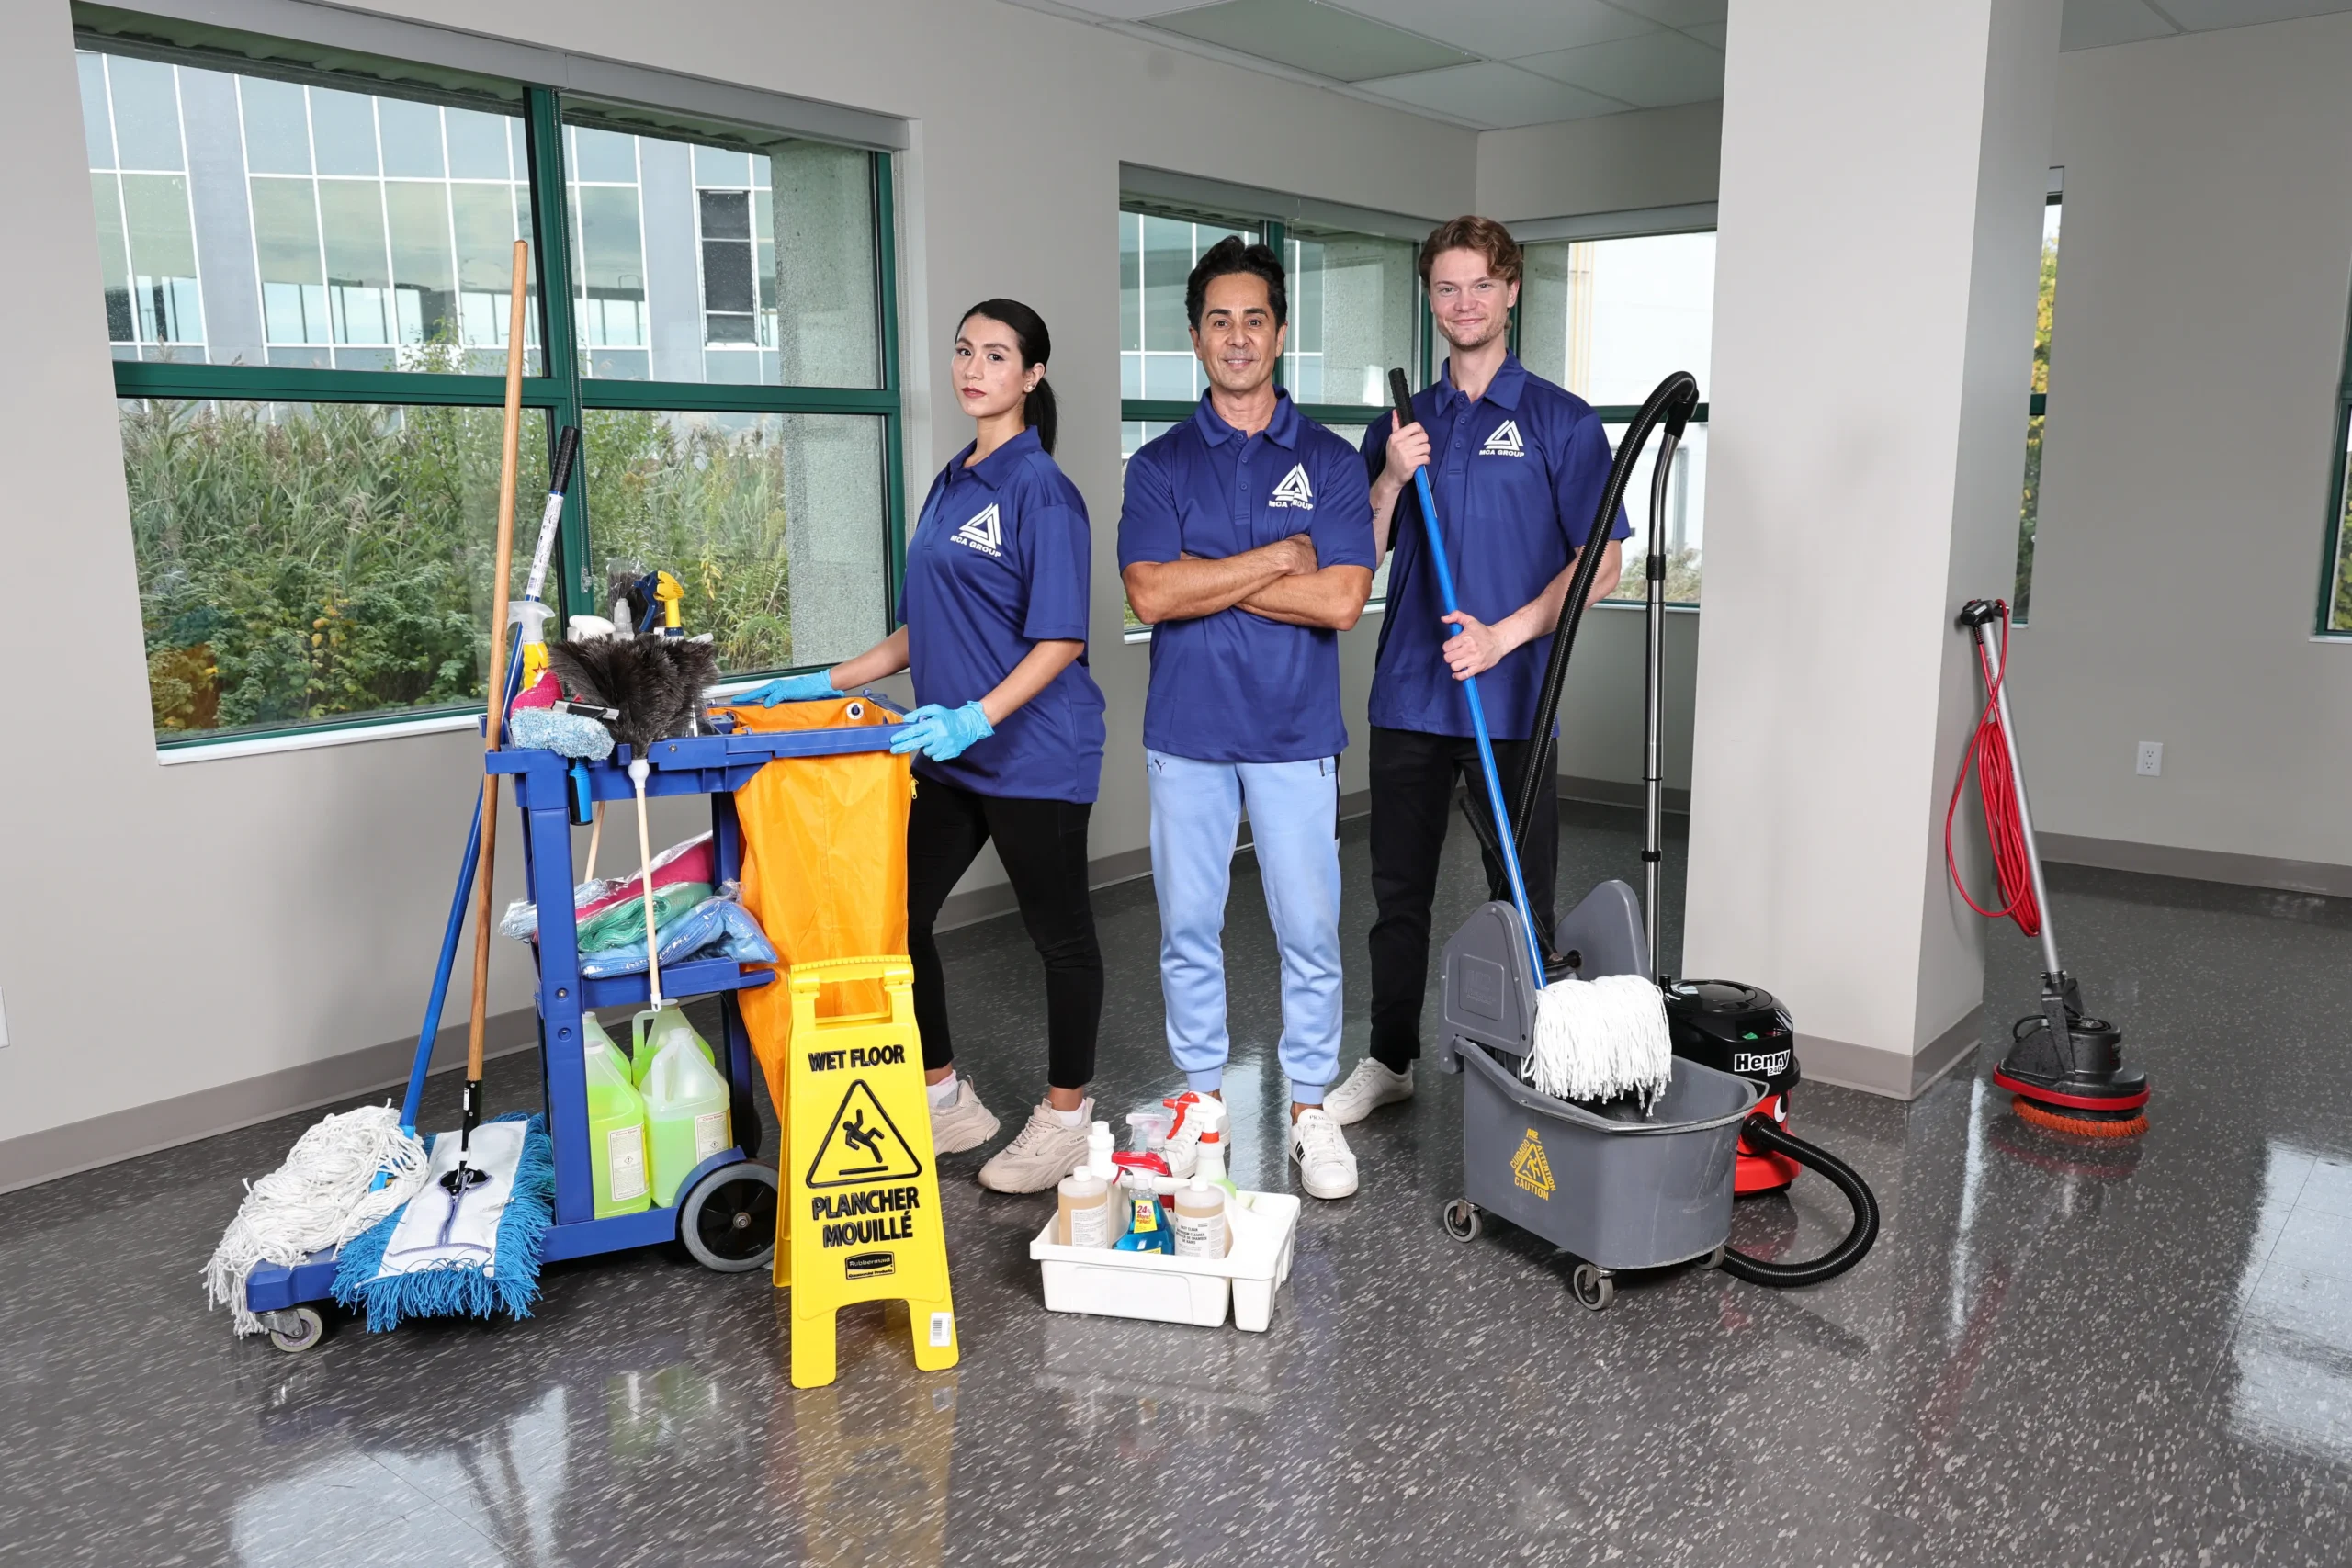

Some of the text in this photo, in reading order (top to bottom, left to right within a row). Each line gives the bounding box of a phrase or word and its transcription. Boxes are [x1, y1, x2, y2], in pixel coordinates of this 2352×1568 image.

[1498, 449, 1525, 457] GROUP
[1269, 499, 1314, 511] MCA ROUP
[950, 535, 1001, 557] MCA GROUP
[808, 1043, 906, 1072] WET FLOOR
[1734, 1049, 1791, 1072] Henry
[1769, 1066, 1781, 1075] 240
[1510, 1139, 1531, 1169] CUIDADO
[1536, 1145, 1556, 1191] ATTENTION
[1514, 1177, 1549, 1201] CAUTION
[812, 1186, 920, 1221] PLANCHER
[822, 1210, 913, 1248] MOUILLÉ
[849, 1257, 891, 1267] Rubbermaid
